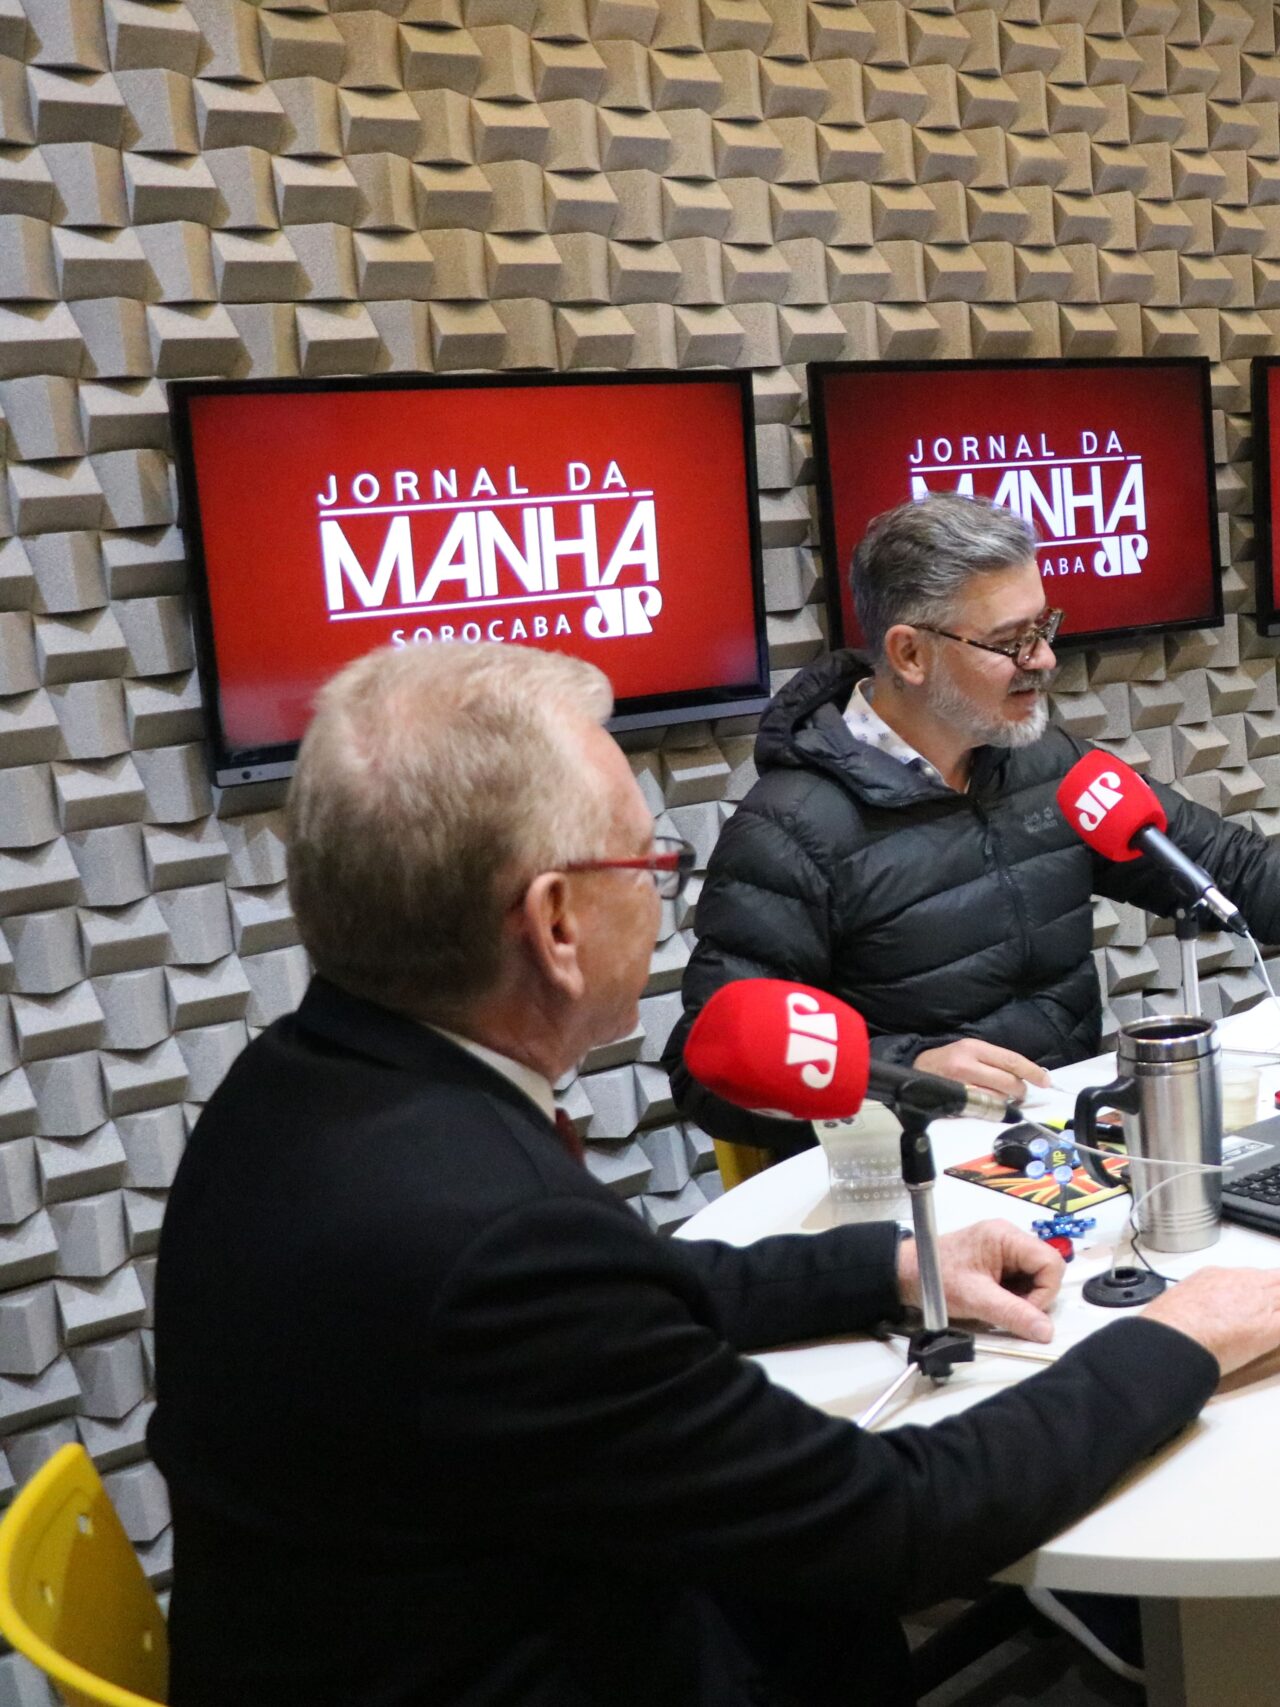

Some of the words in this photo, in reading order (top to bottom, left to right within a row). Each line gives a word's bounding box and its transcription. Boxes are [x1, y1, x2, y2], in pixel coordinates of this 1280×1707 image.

[910, 433, 1055, 464] JORNAL
[1082, 430, 1123, 455] DA
[318, 464, 529, 506] JORNAL
[568, 460, 628, 491] DA
[1094, 533, 1149, 577] JP
[584, 585, 663, 639] JP
[1052, 1150, 1067, 1168] VIP
